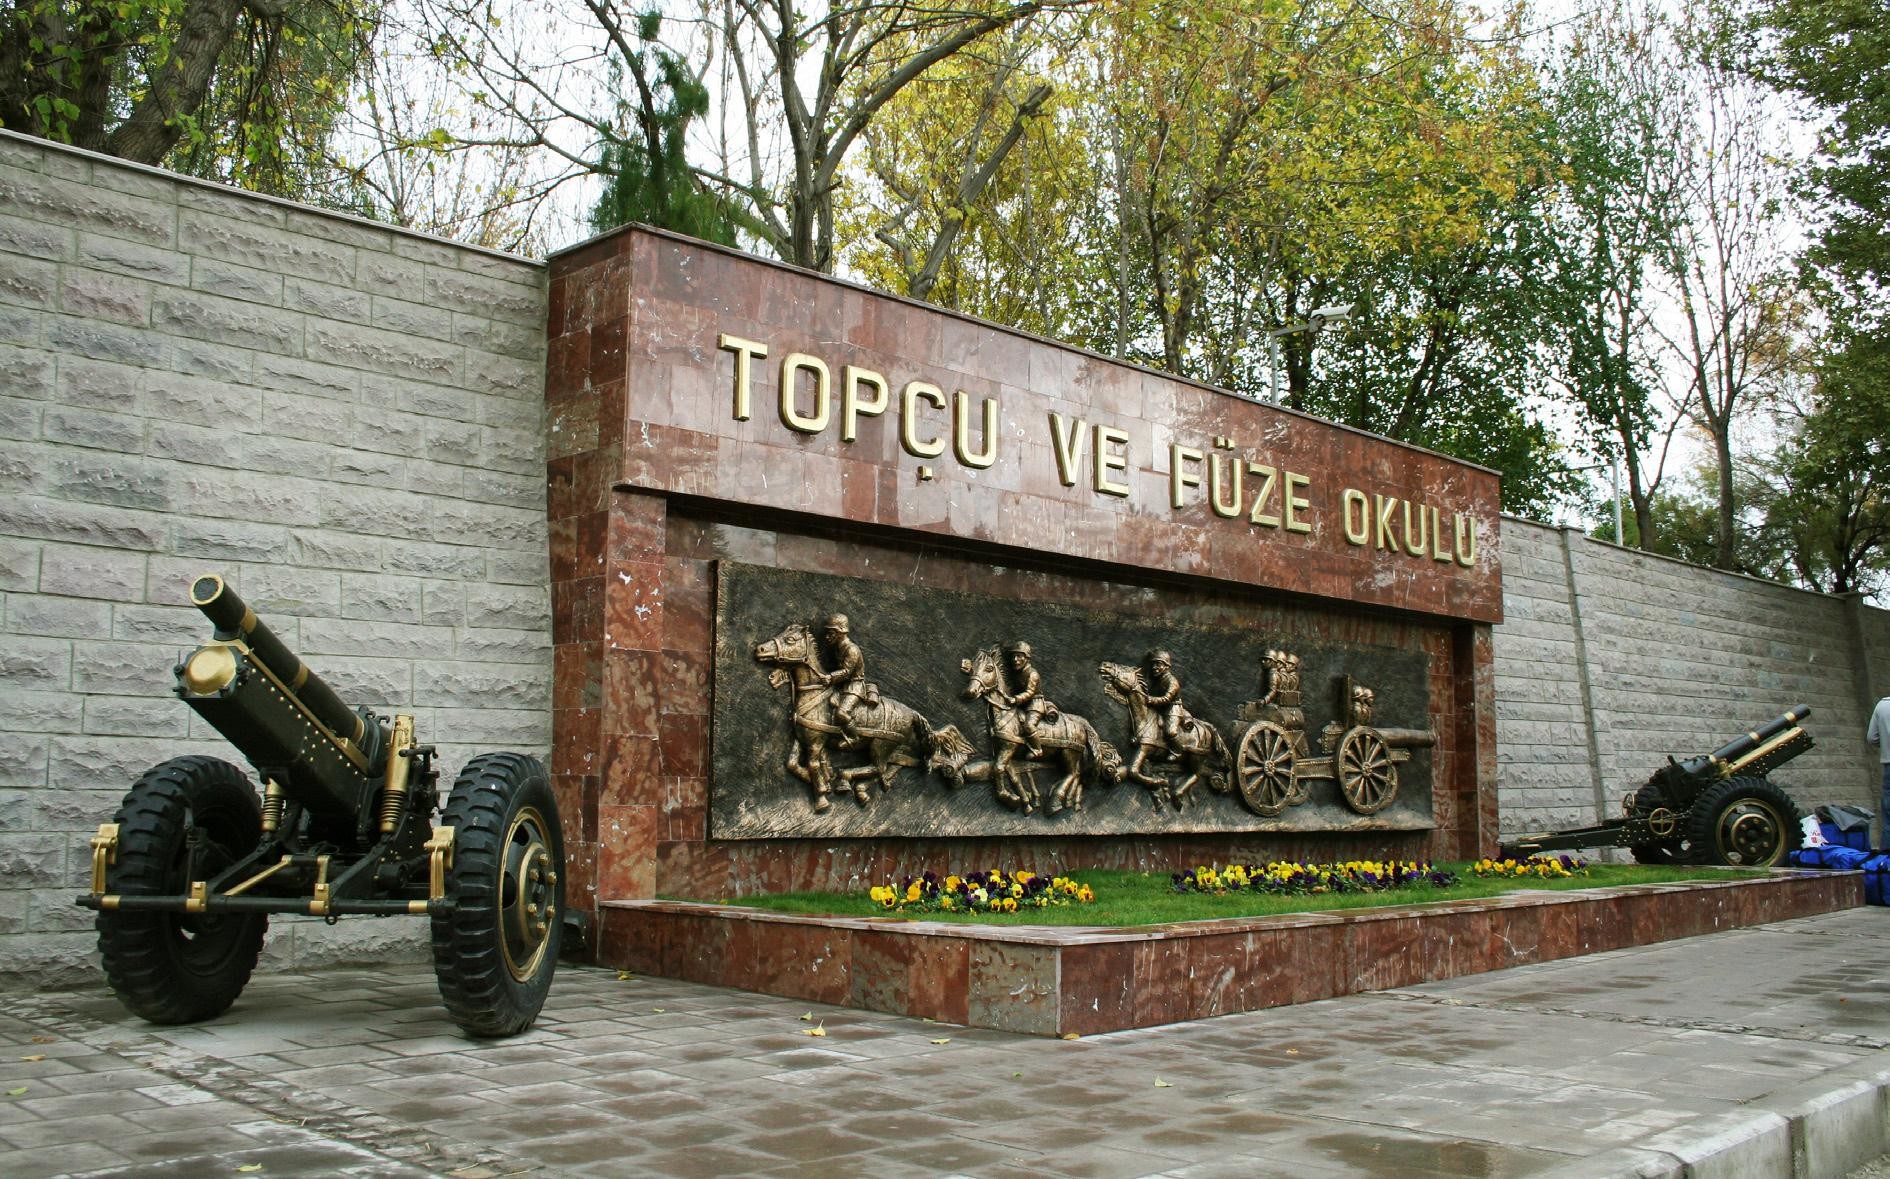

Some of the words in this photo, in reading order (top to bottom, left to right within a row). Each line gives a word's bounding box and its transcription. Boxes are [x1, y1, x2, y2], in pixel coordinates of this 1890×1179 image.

[719, 333, 998, 481] TOPÇU
[1049, 412, 1129, 497] VE
[1170, 435, 1311, 534] FÜZE
[1343, 488, 1476, 567] OKULU
